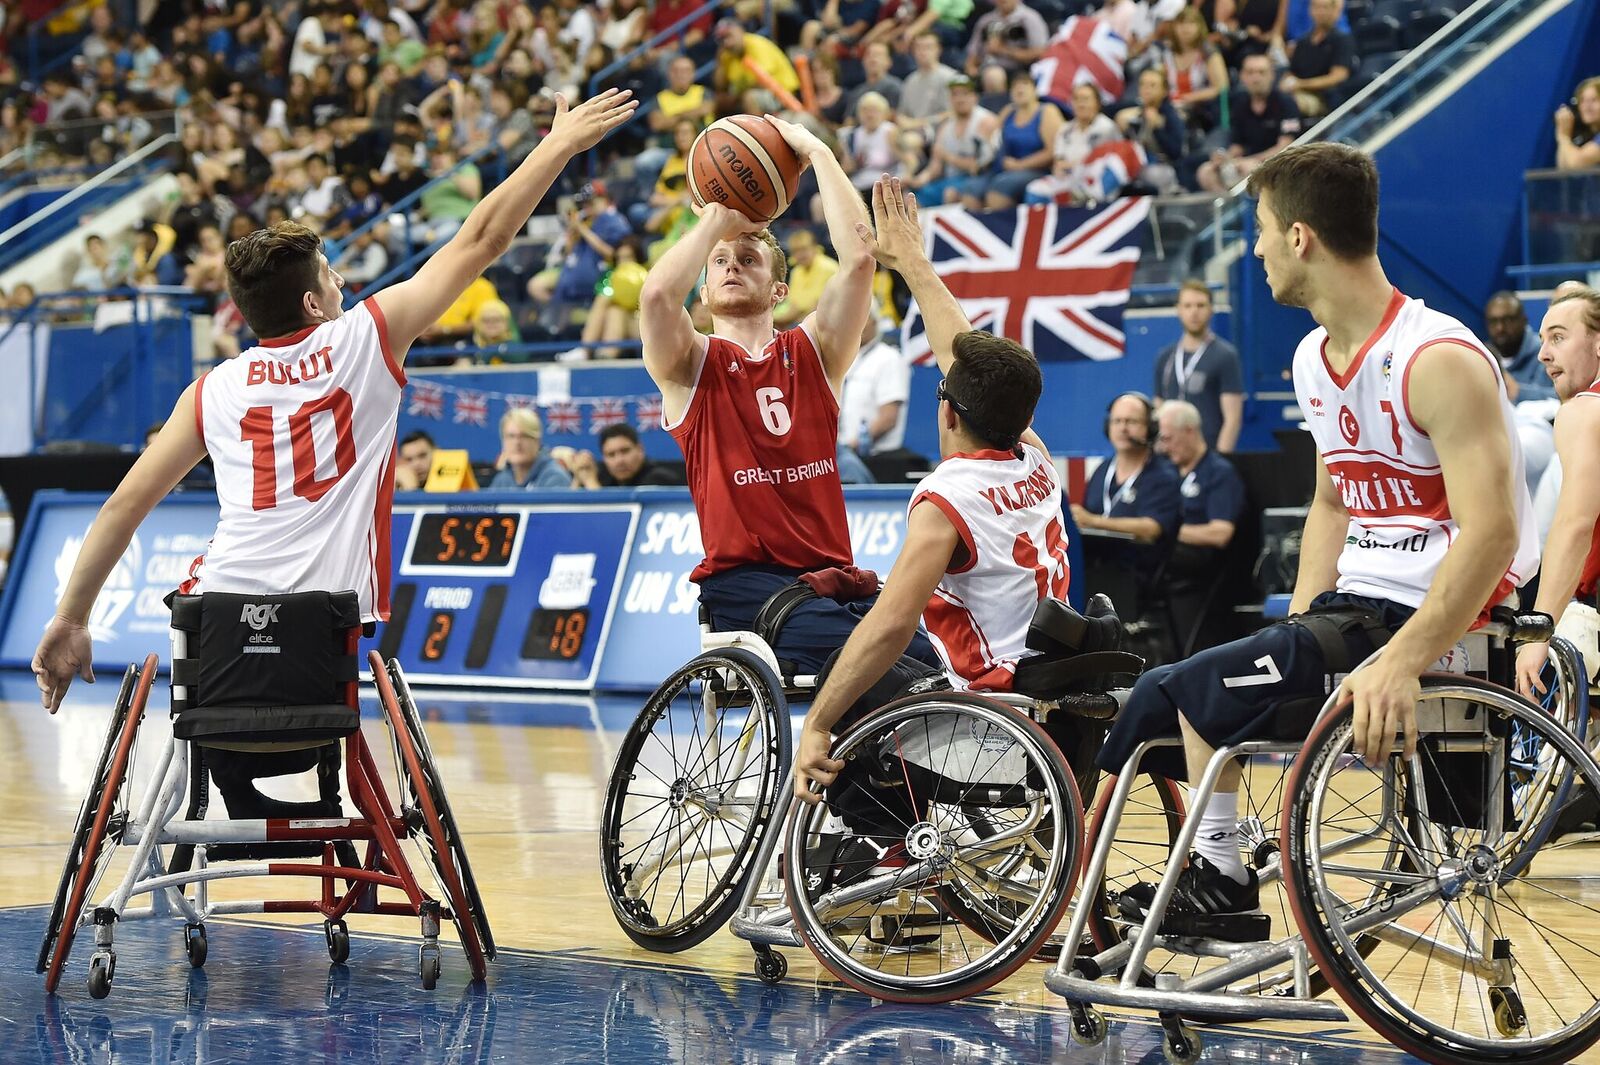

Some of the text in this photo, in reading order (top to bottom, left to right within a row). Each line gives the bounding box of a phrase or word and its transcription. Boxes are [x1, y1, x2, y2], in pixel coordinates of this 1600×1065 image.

[708, 178, 729, 202] FIBA
[719, 144, 765, 202] molten
[247, 346, 333, 386] BULUT
[755, 386, 792, 436] 6
[1380, 400, 1402, 456] 7
[239, 387, 357, 511] 10
[734, 458, 835, 486] GREAT BRITAIN
[437, 518, 515, 561] 5:57
[240, 604, 281, 630] RGK
[424, 586, 474, 609] PERIOD
[249, 633, 273, 643] elite
[425, 614, 450, 658] 2
[550, 612, 587, 657] 18
[1222, 654, 1283, 688] 7
